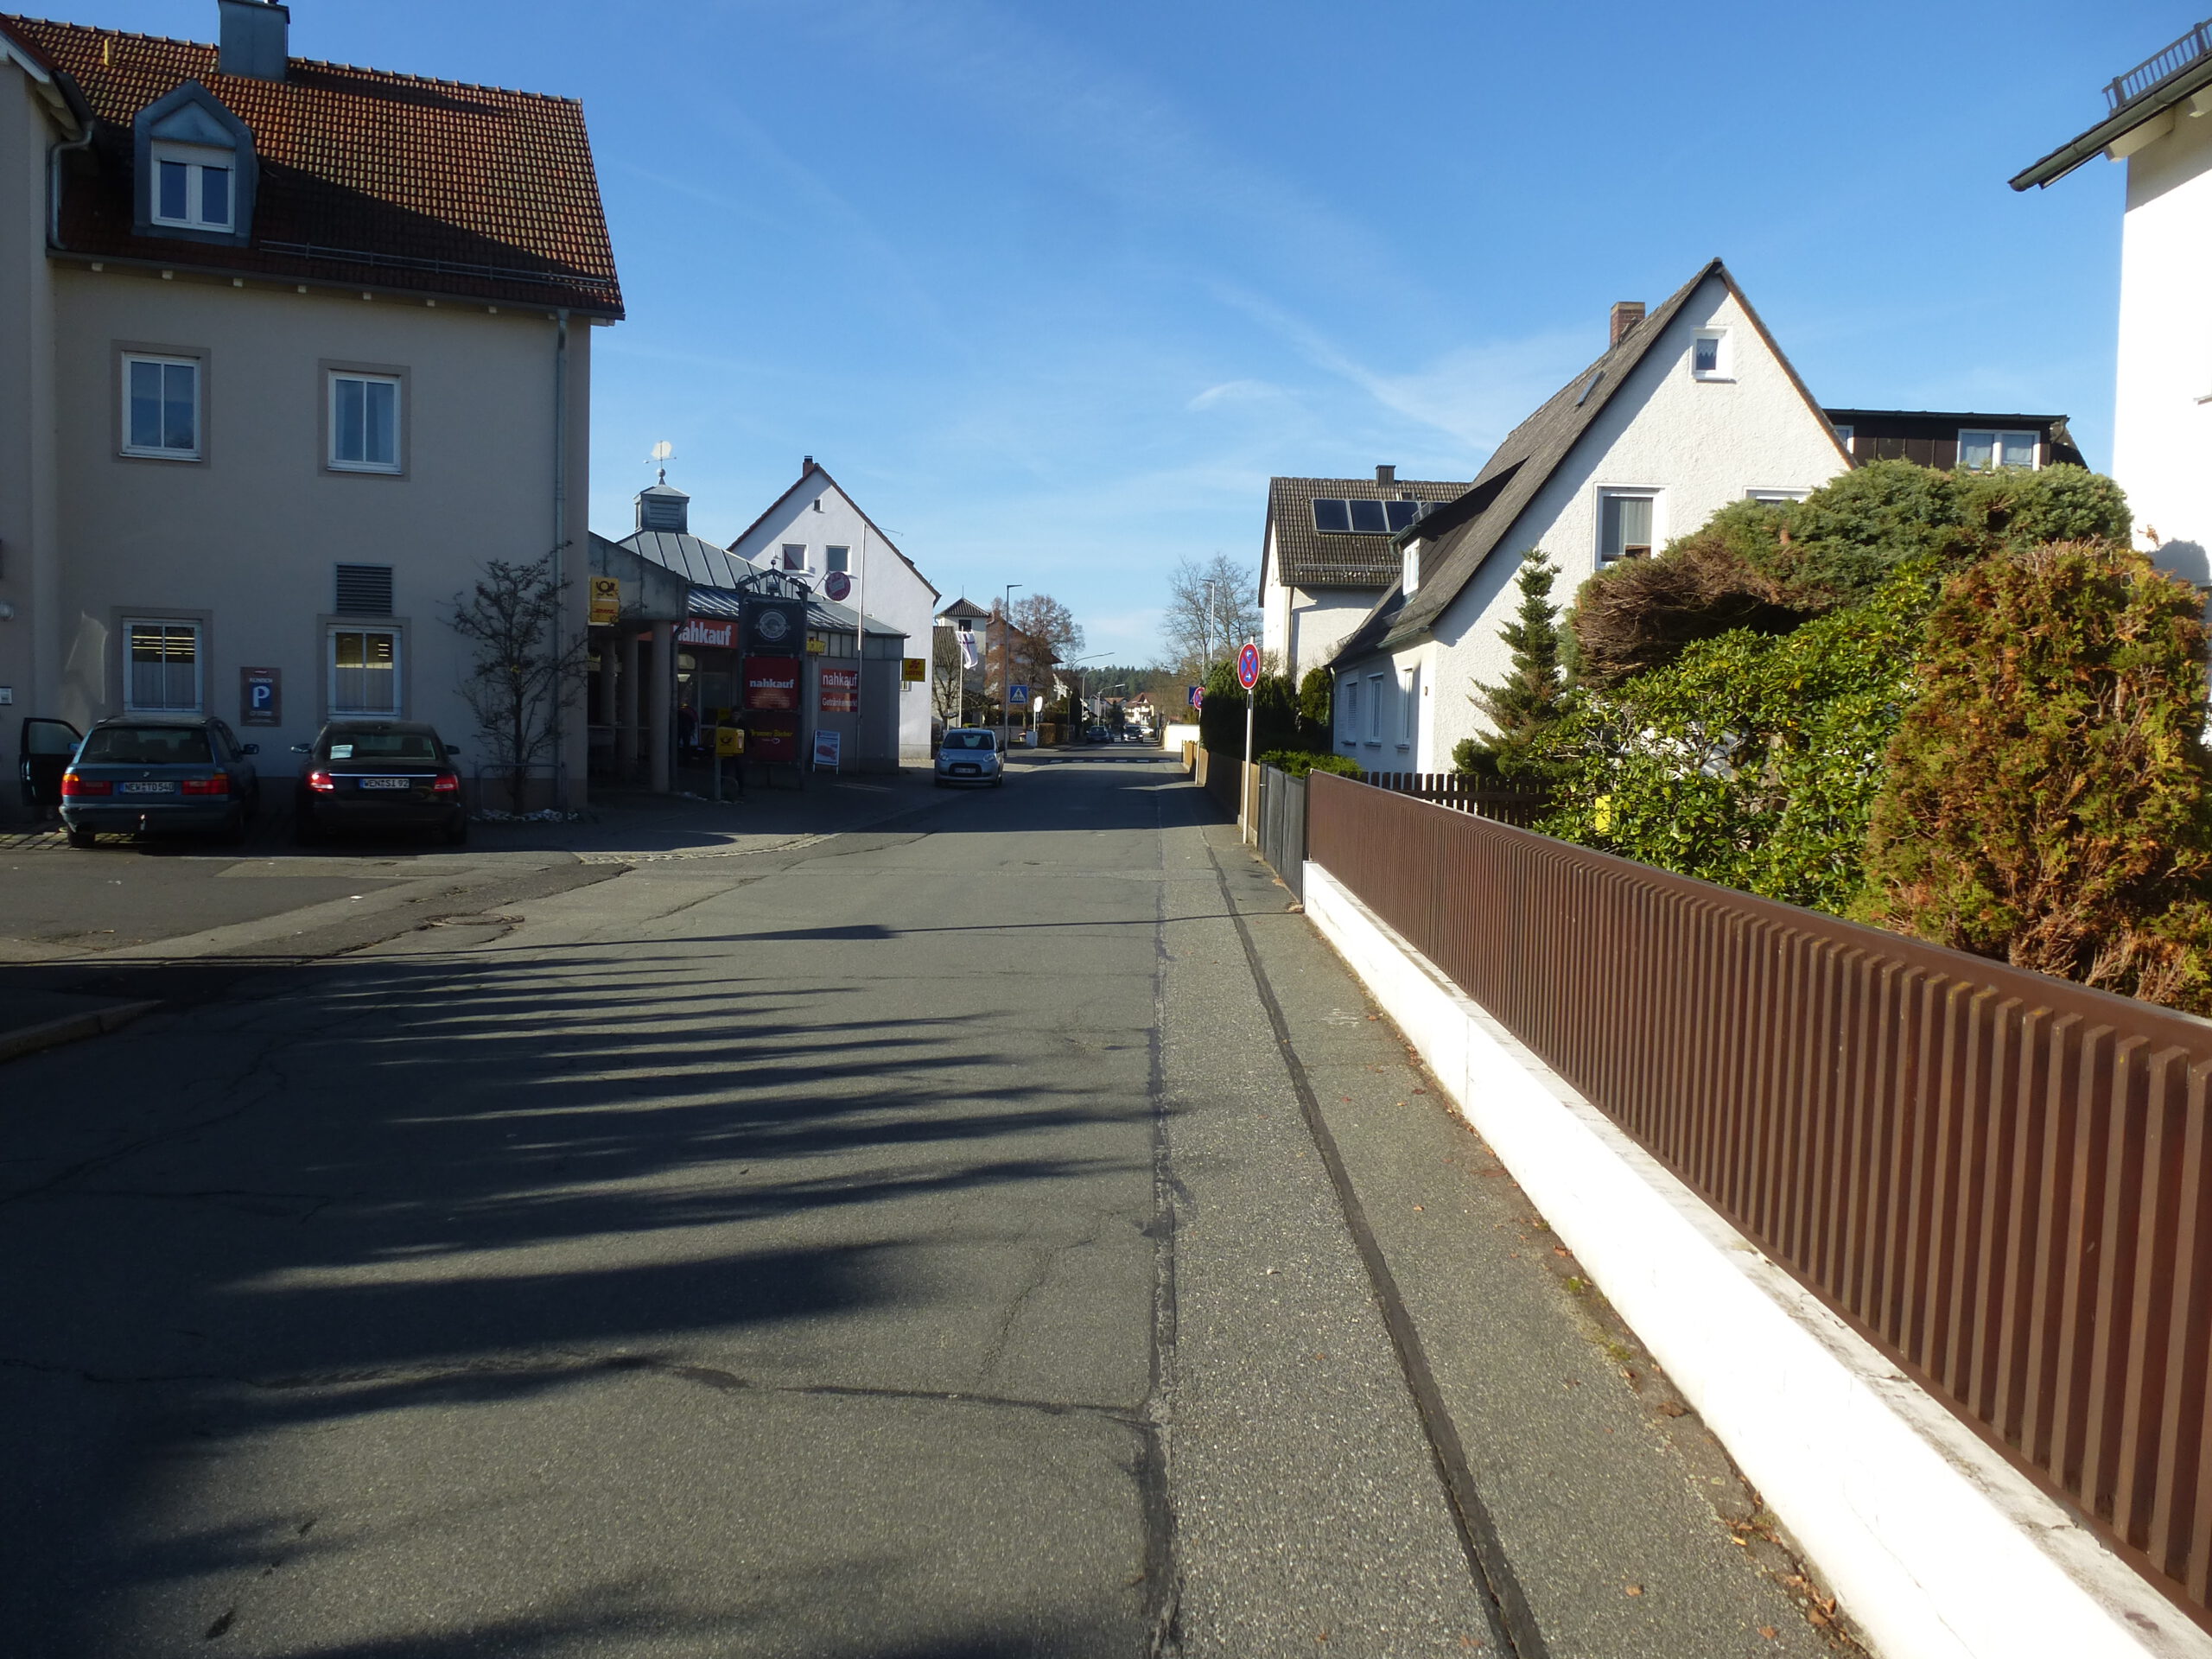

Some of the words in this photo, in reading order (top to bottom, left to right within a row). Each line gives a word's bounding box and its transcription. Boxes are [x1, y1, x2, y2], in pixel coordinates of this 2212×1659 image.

[749, 677, 796, 690] nahkauf
[822, 671, 858, 687] nahkauf
[252, 685, 270, 708] P
